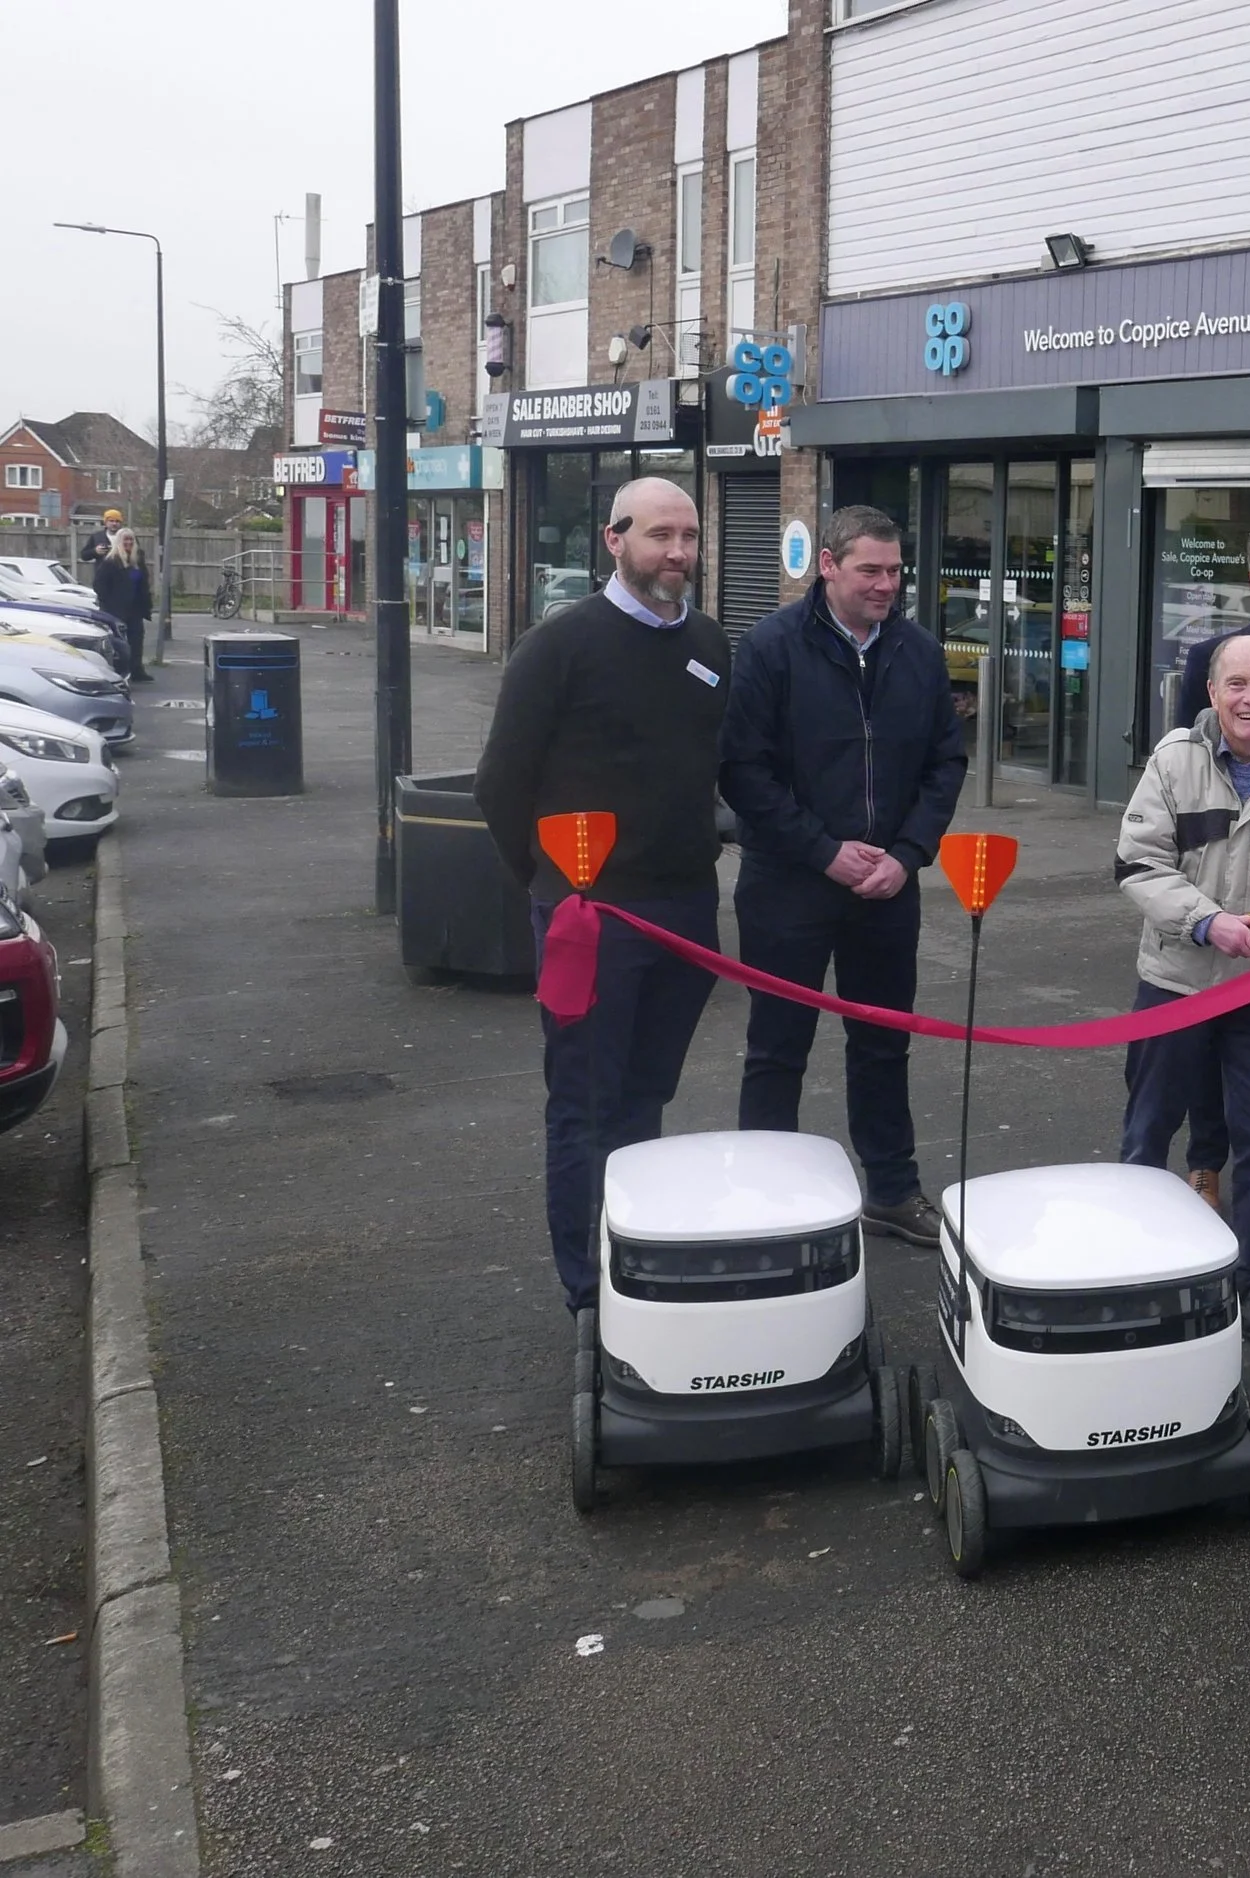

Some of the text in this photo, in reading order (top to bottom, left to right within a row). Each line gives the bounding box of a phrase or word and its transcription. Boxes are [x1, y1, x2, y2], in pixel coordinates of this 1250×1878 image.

[1024, 325, 1094, 352] Welcome
[1098, 325, 1115, 345] to
[1119, 316, 1190, 348] Coppice
[512, 391, 631, 421] SALE BARBER SHOP
[762, 419, 773, 429] JUST
[273, 456, 325, 483] BETFRED
[1181, 538, 1225, 549] Welcome to
[1161, 552, 1246, 565] Sale, Coppice Avenue's
[1190, 566, 1214, 579] Co-op
[690, 1369, 785, 1390] STARSHIP
[1087, 1421, 1182, 1447] STARSHIP
